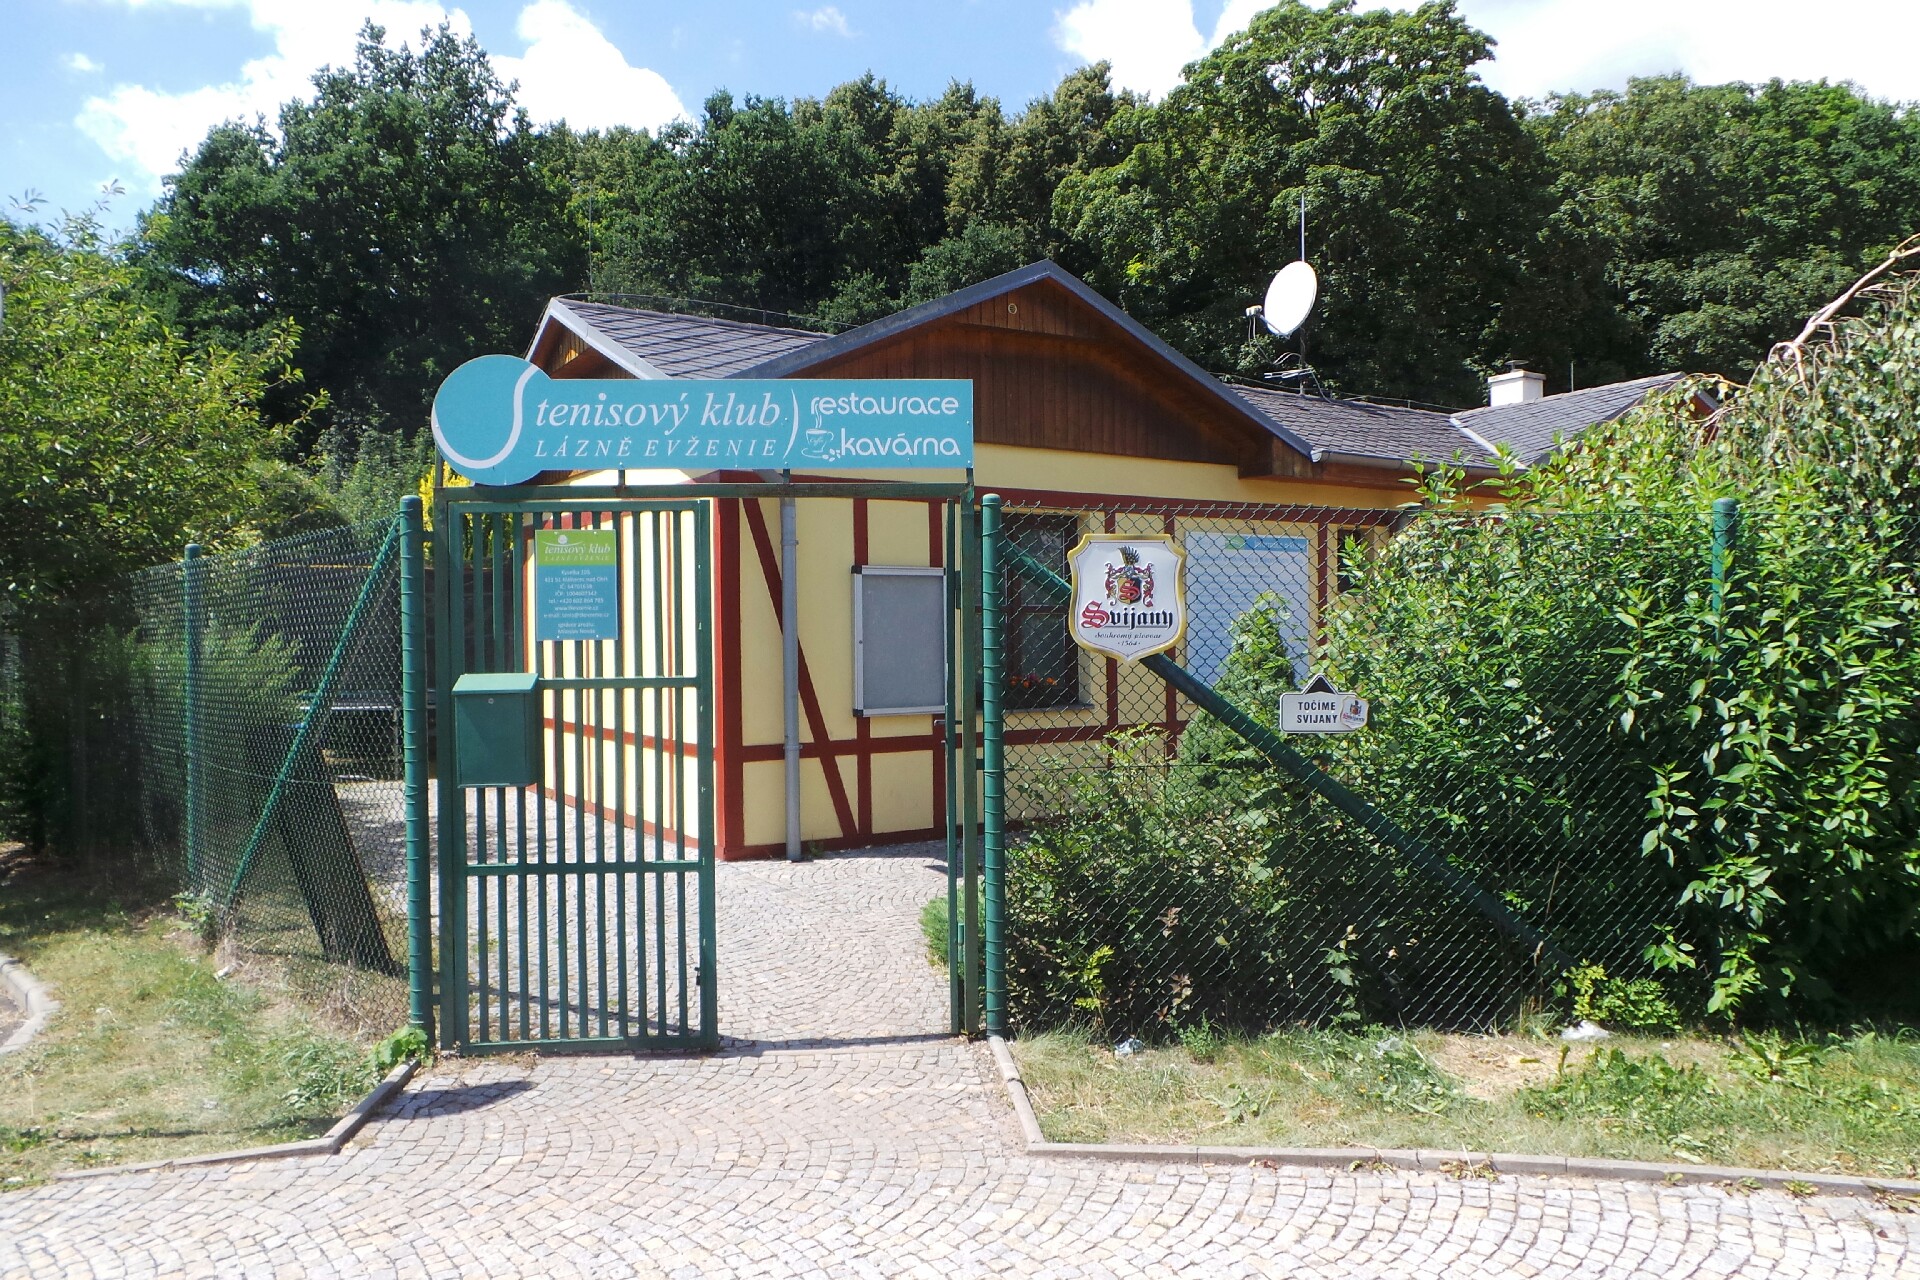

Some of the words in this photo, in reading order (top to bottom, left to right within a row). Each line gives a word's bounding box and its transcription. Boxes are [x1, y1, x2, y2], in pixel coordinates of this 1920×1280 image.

[536, 393, 690, 435] tenisový
[700, 393, 780, 427] klub
[811, 393, 959, 415] restaurace
[535, 436, 632, 457] LÁZNĚ
[645, 435, 777, 457] EVŽENIE
[841, 427, 961, 456] kavárna
[544, 545, 586, 556] tenisový
[588, 543, 611, 554] klub
[1081, 600, 1173, 629] Svijany
[1298, 700, 1336, 711] TOČÍME
[1297, 714, 1338, 724] SVIJANY
